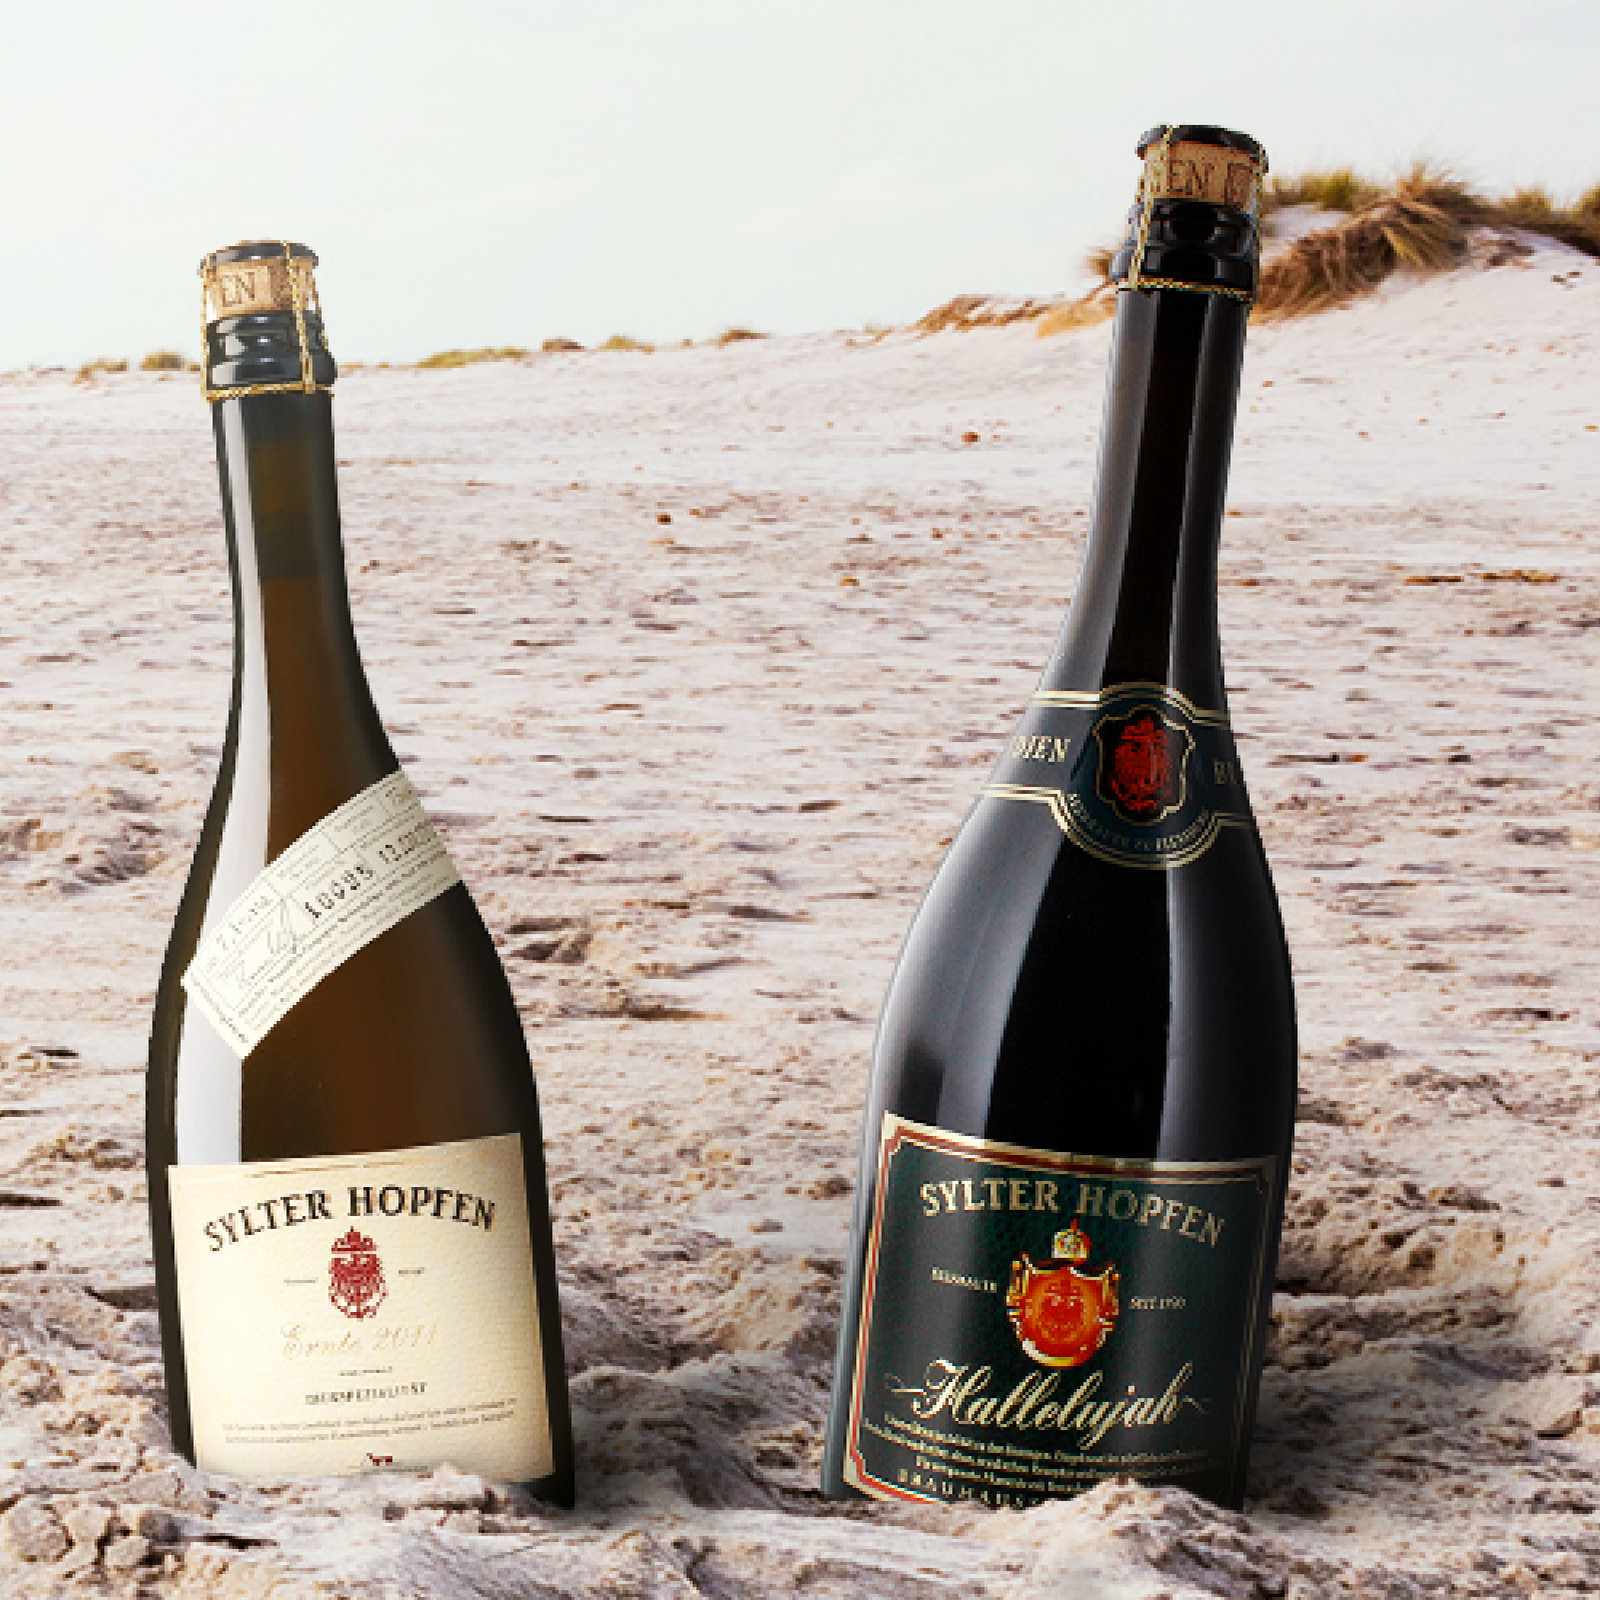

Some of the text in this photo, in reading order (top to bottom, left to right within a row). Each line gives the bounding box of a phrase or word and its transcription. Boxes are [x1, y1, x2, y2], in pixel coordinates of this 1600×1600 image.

[203, 1183, 496, 1252] SYLTER HOPFEN
[919, 1177, 1226, 1248] SYLTER HOPFEN
[892, 1359, 1198, 1451] Hallelujah
